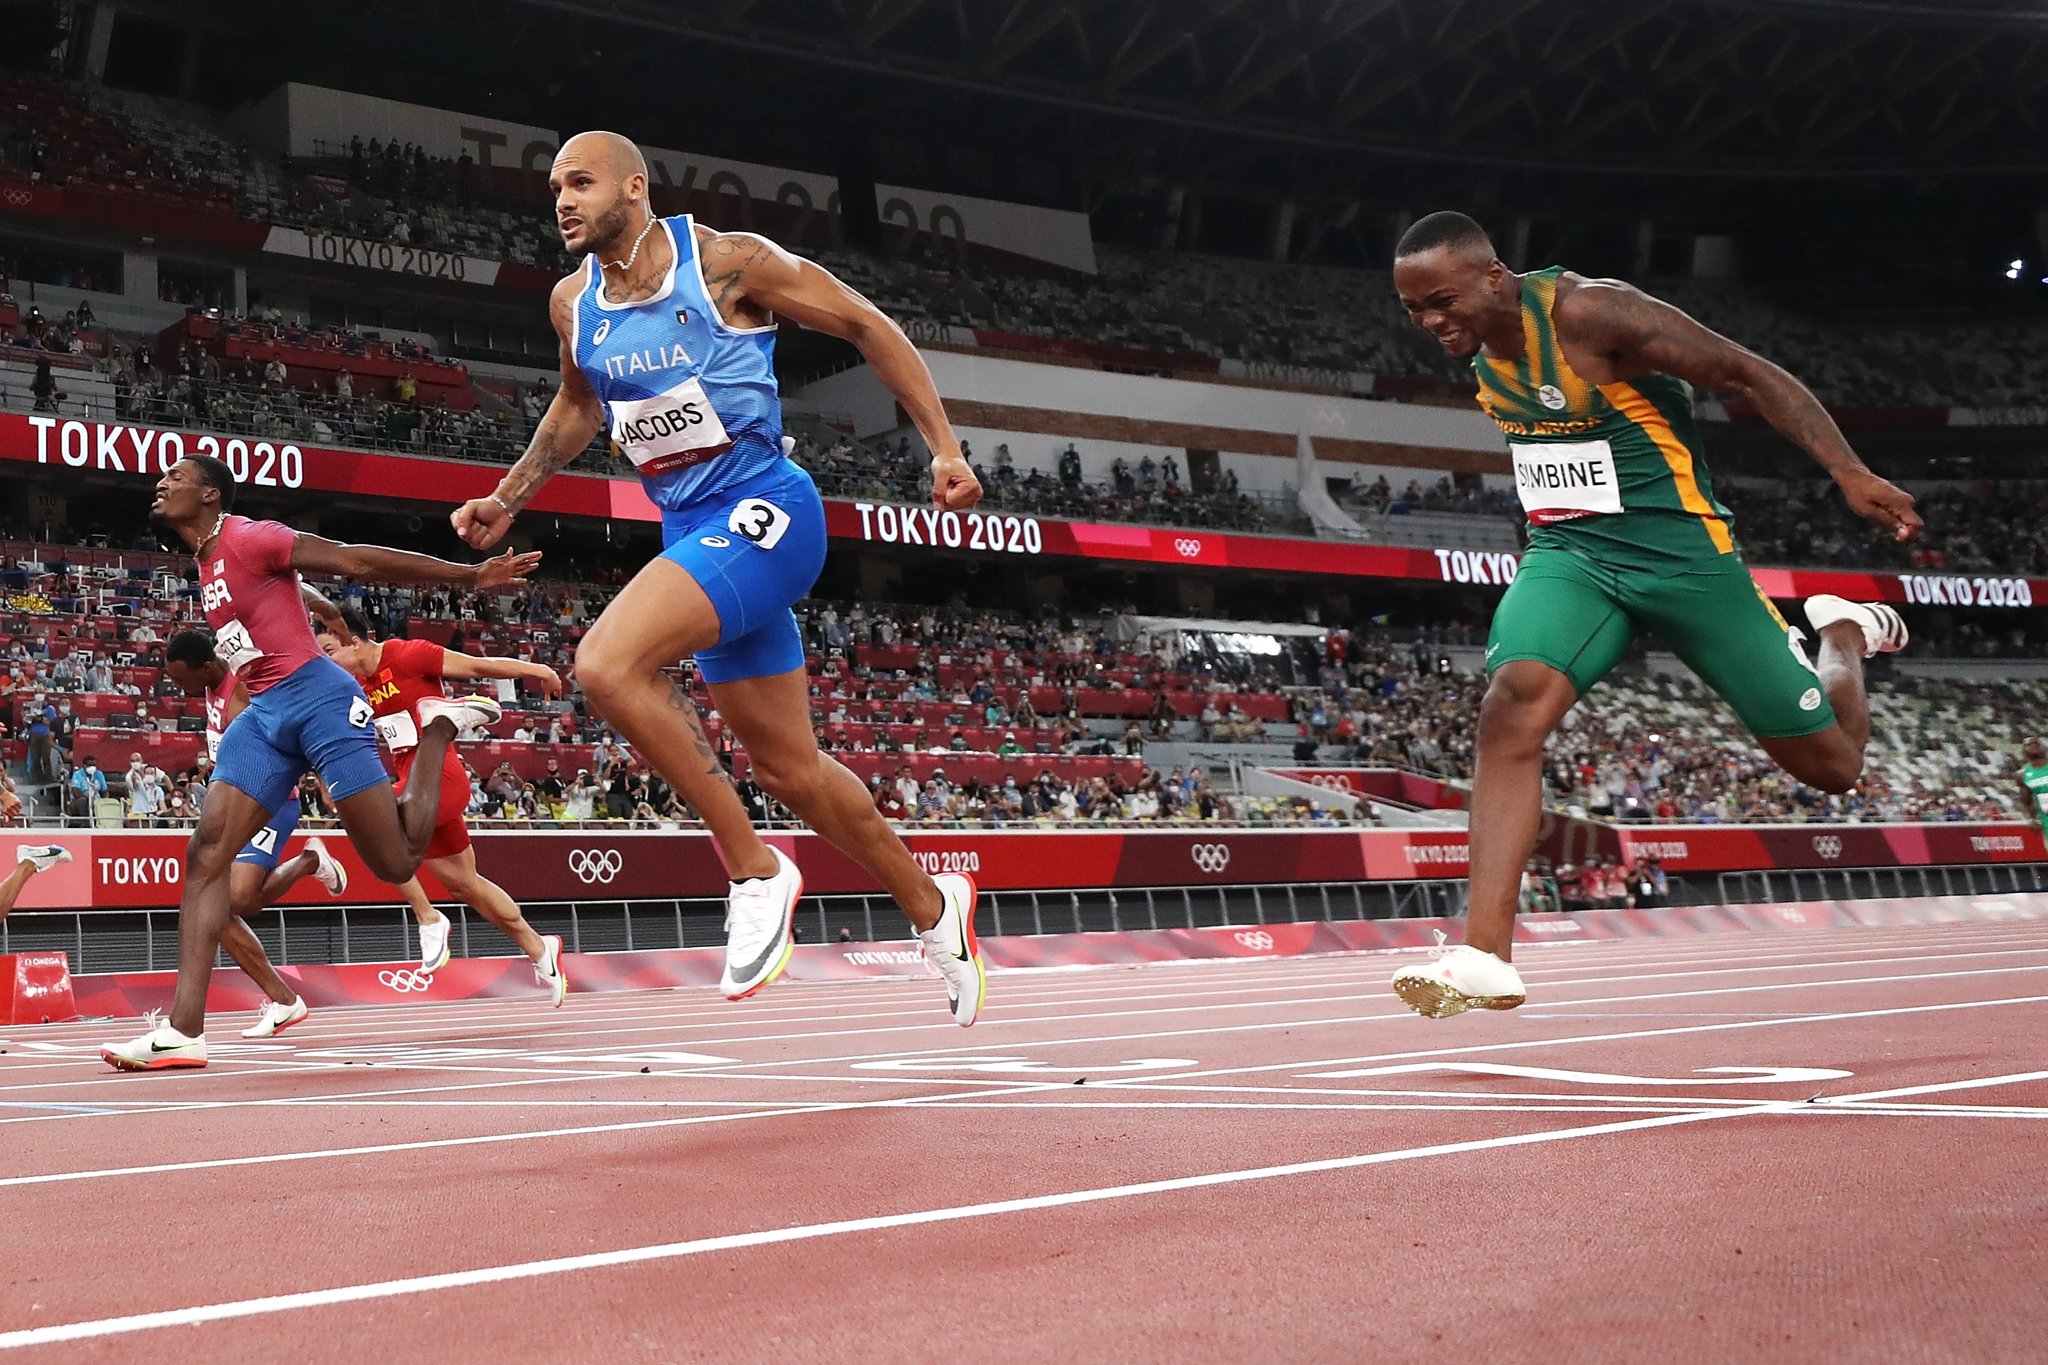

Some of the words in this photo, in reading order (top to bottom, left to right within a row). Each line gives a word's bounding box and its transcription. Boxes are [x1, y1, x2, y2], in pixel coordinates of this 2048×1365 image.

[401, 249, 465, 281] 2020
[605, 344, 692, 379] ITALIA
[617, 402, 704, 445] JACOBS
[28, 416, 184, 475] TOKYO
[1518, 461, 1607, 488] SIMBINE
[738, 504, 775, 542] 3
[855, 503, 962, 548] TOKYO
[967, 513, 1041, 555] 2020
[1434, 548, 1518, 586] TOKYO
[201, 578, 233, 613] USA
[1898, 574, 1974, 607] TOKYO
[1972, 577, 2033, 607] 2020
[368, 681, 401, 706] HINA
[384, 725, 398, 739] SU
[258, 828, 271, 846] 7
[98, 858, 181, 884] TOKYO
[941, 852, 980, 872] 2020
[33, 957, 61, 966] OMEGA
[843, 951, 894, 966] TOKYO
